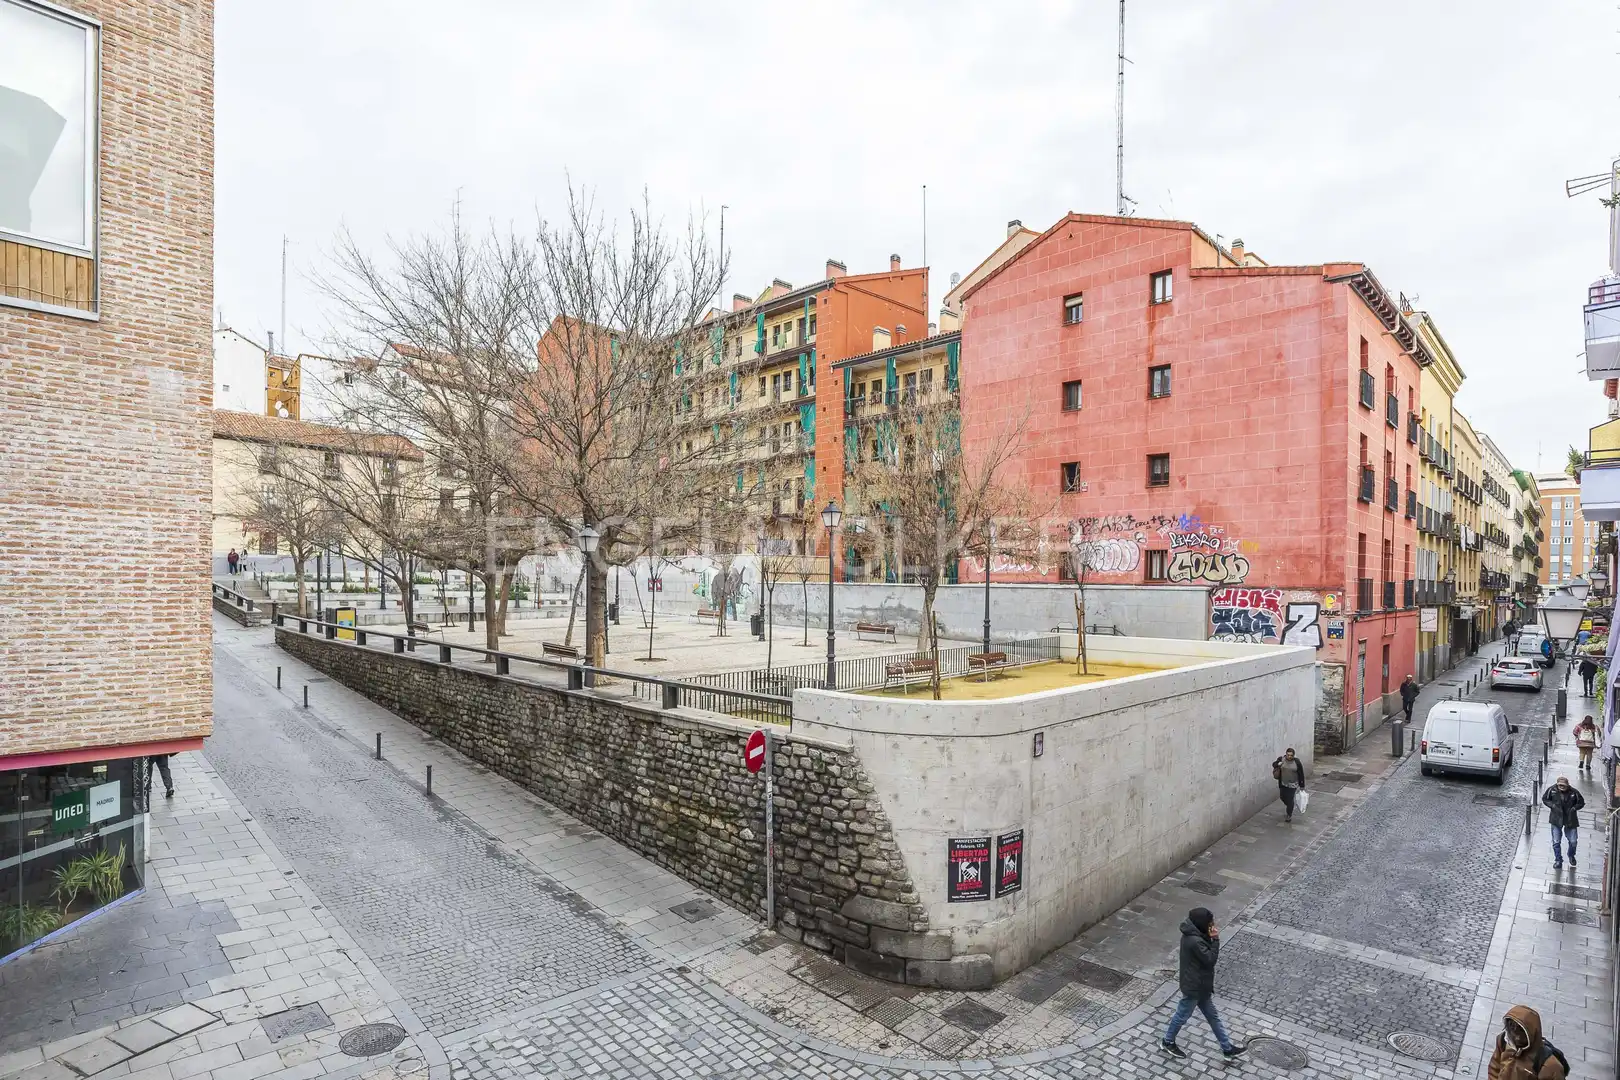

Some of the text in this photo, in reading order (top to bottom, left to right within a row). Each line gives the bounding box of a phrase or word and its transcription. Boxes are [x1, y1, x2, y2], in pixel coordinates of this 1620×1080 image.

[96, 797, 115, 806] MADRID
[55, 803, 84, 821] UNED
[951, 849, 988, 857] LIBERTAD
